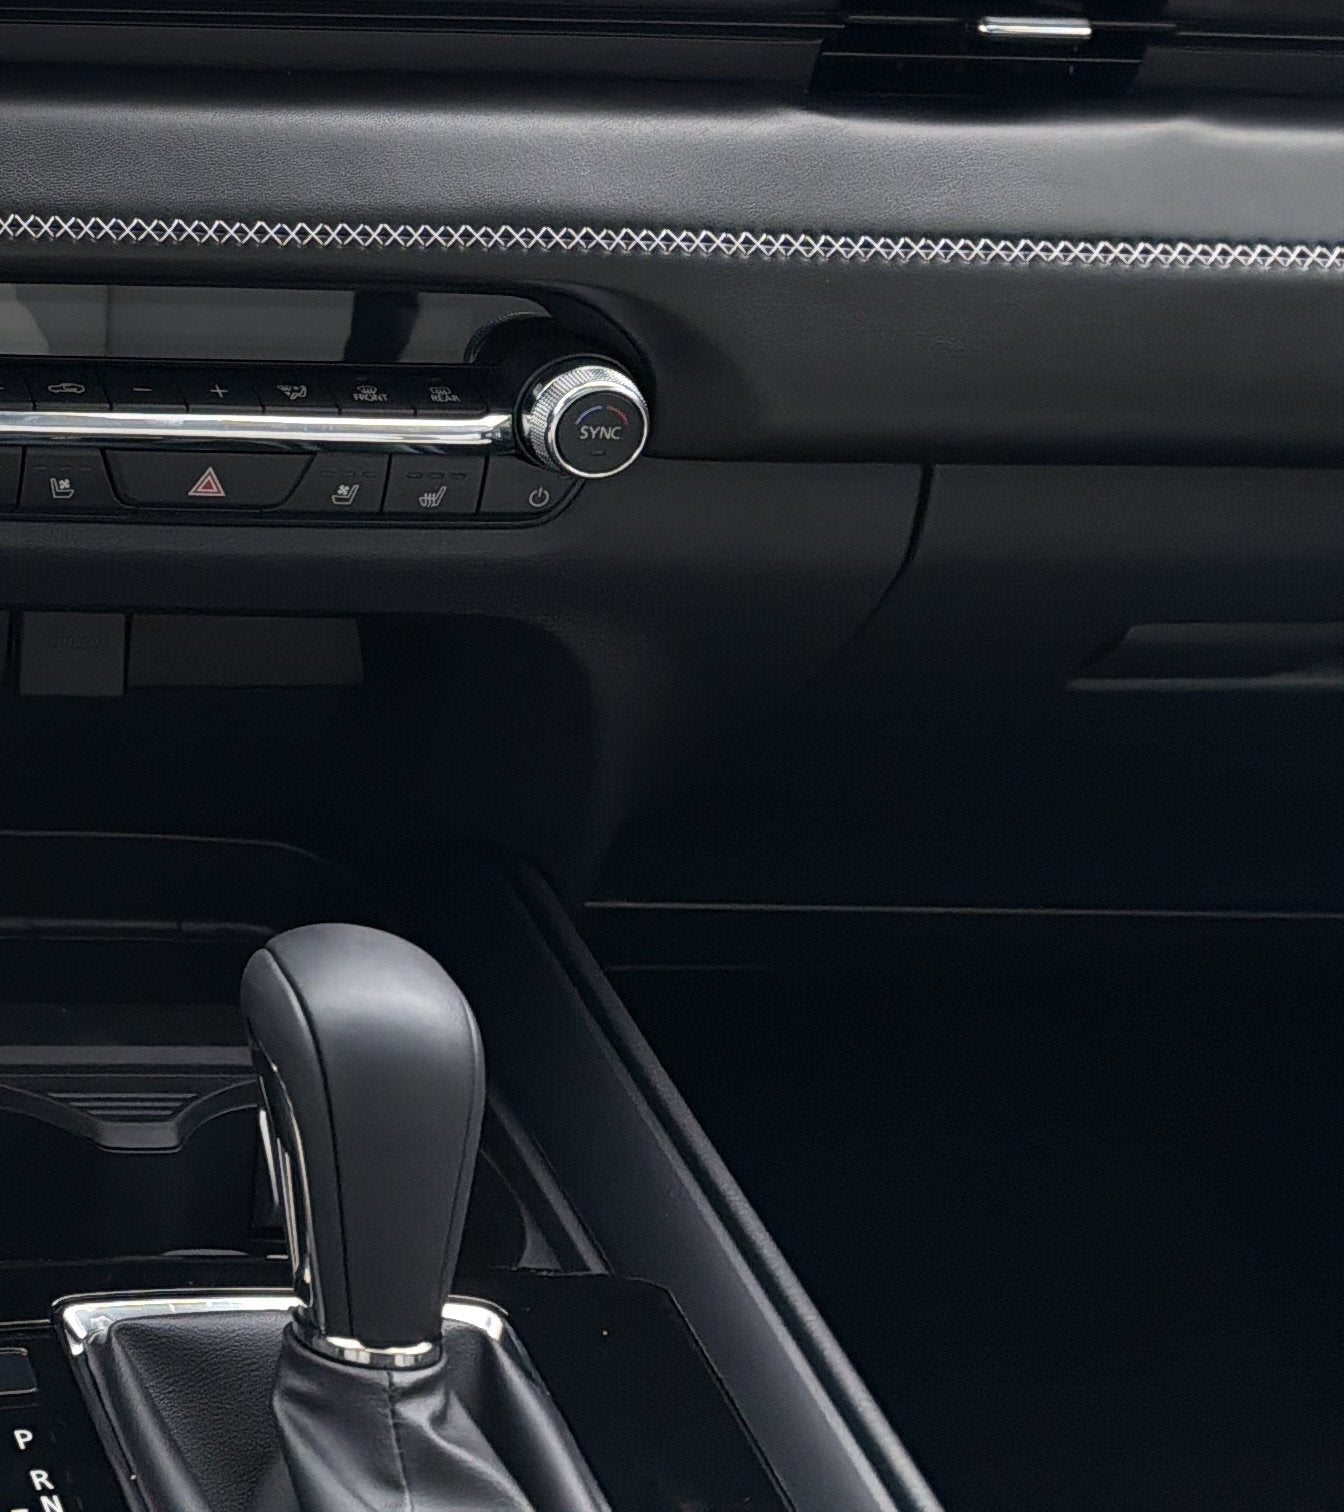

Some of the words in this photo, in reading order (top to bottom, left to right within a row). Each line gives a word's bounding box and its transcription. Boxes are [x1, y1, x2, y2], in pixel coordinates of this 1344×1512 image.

[353, 391, 389, 403] FRONT
[430, 392, 461, 404] REAR
[579, 426, 622, 441] SYNC
[13, 1429, 33, 1450] P
[29, 1469, 54, 1491] R
[39, 1494, 64, 1512] N
